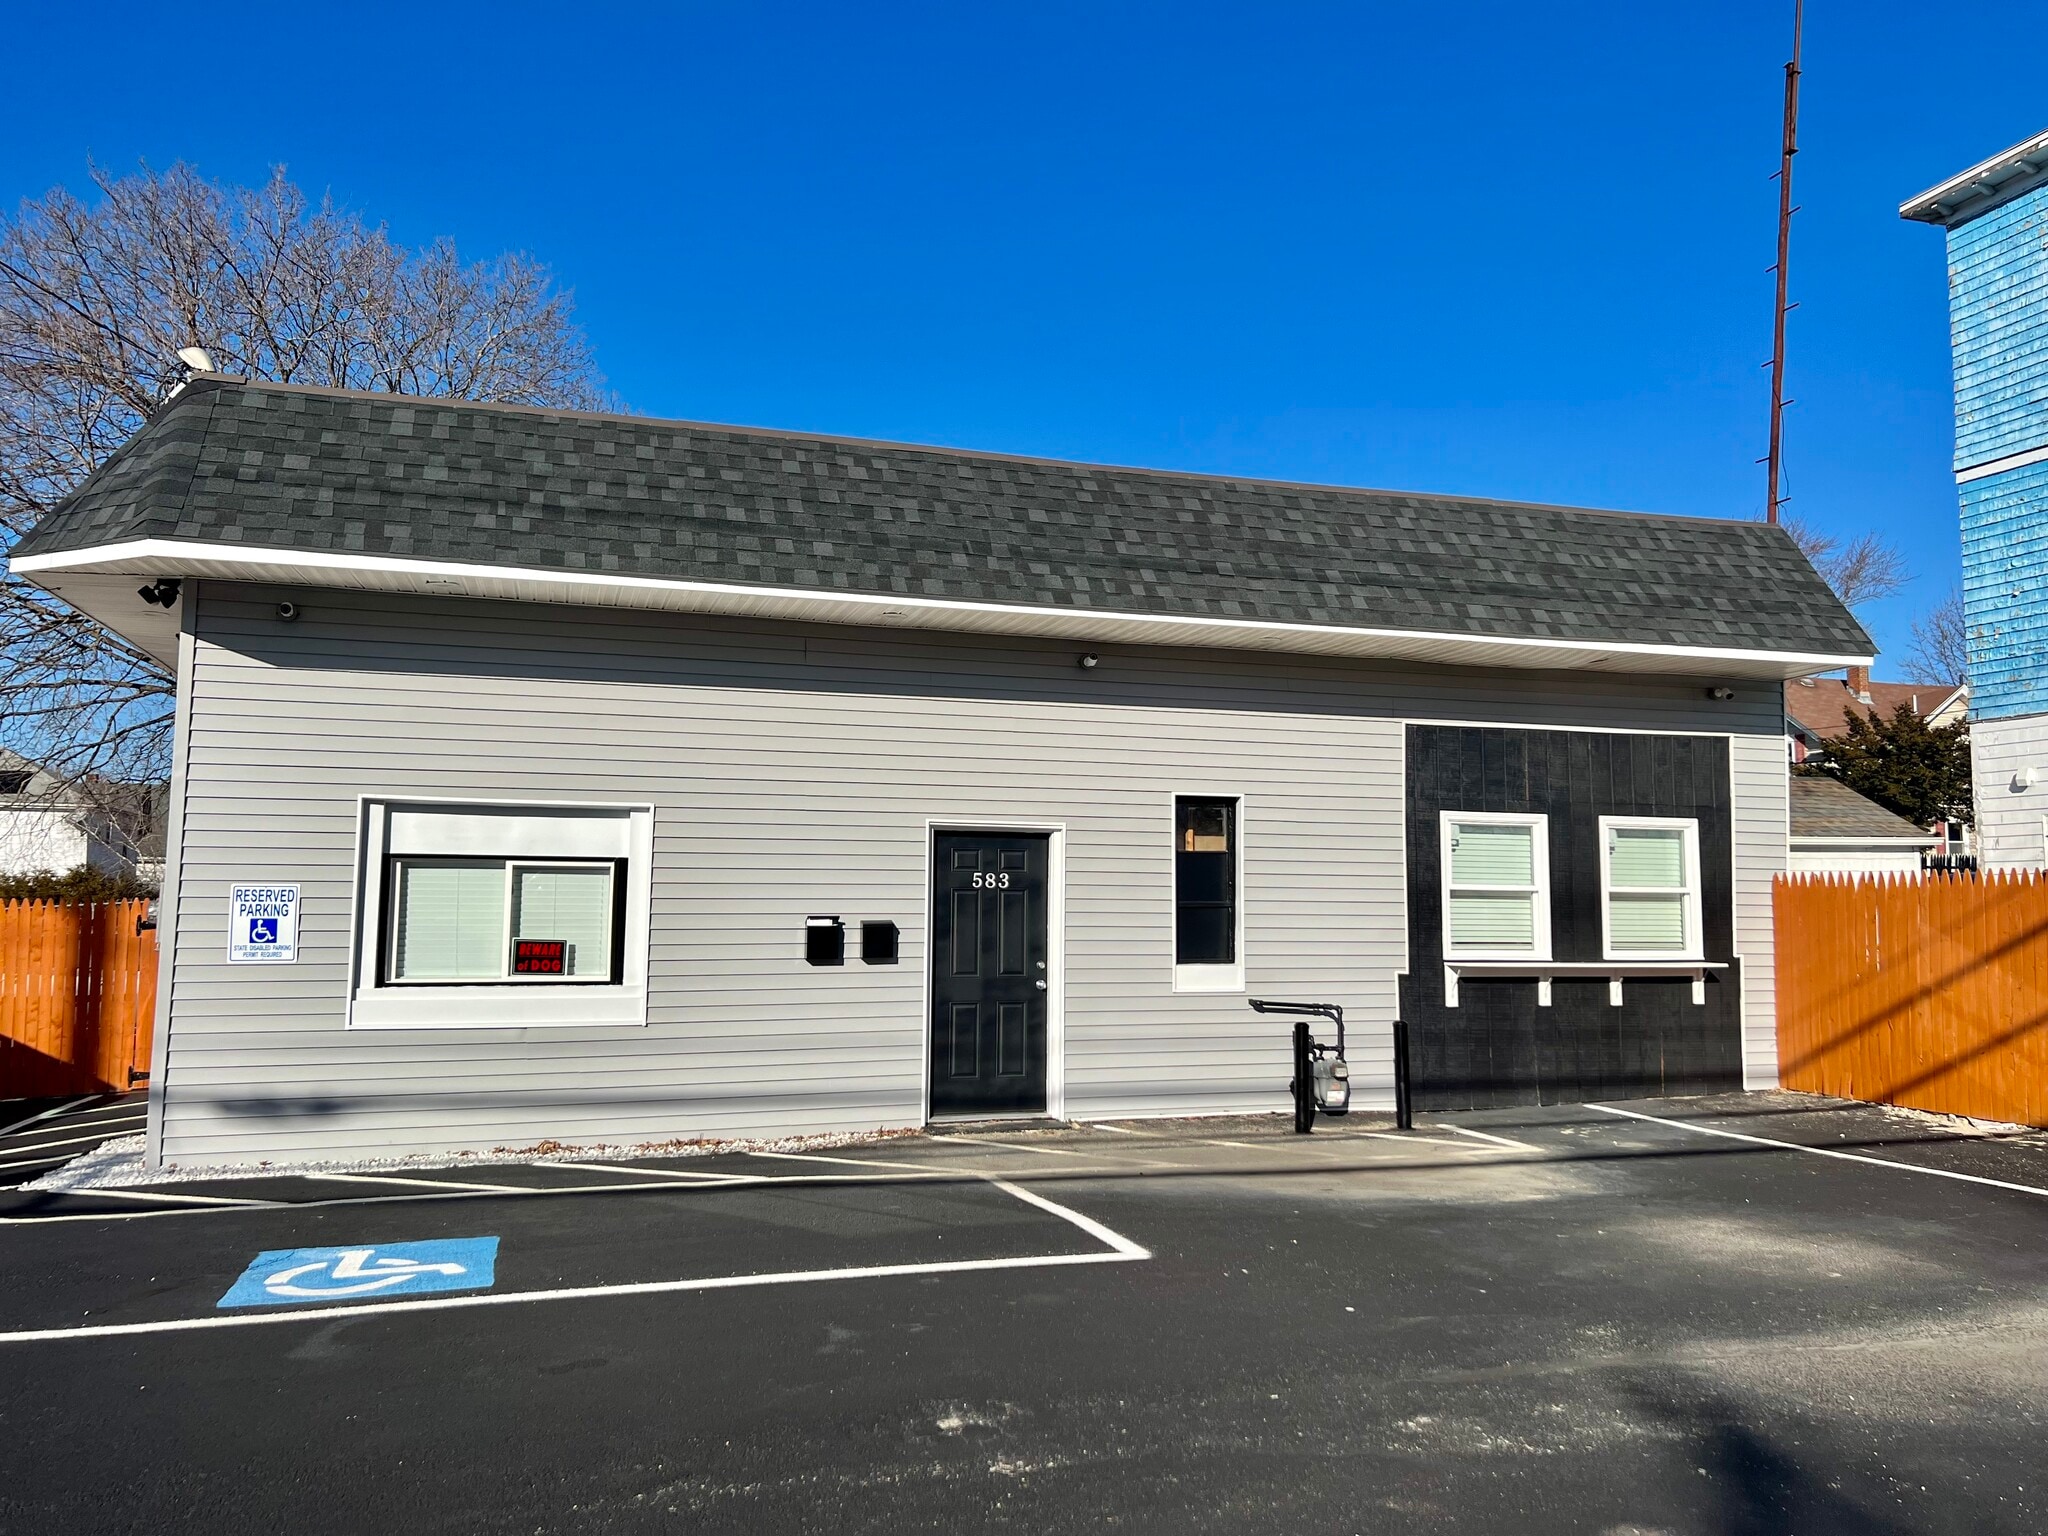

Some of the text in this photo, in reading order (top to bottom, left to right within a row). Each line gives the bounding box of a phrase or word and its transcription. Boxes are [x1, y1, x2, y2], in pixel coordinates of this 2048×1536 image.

[972, 872, 1009, 888] 583
[235, 889, 295, 902] RESERVED
[239, 903, 289, 917] PARKING
[519, 943, 562, 956] BEWARE
[517, 959, 561, 972] of DOG
